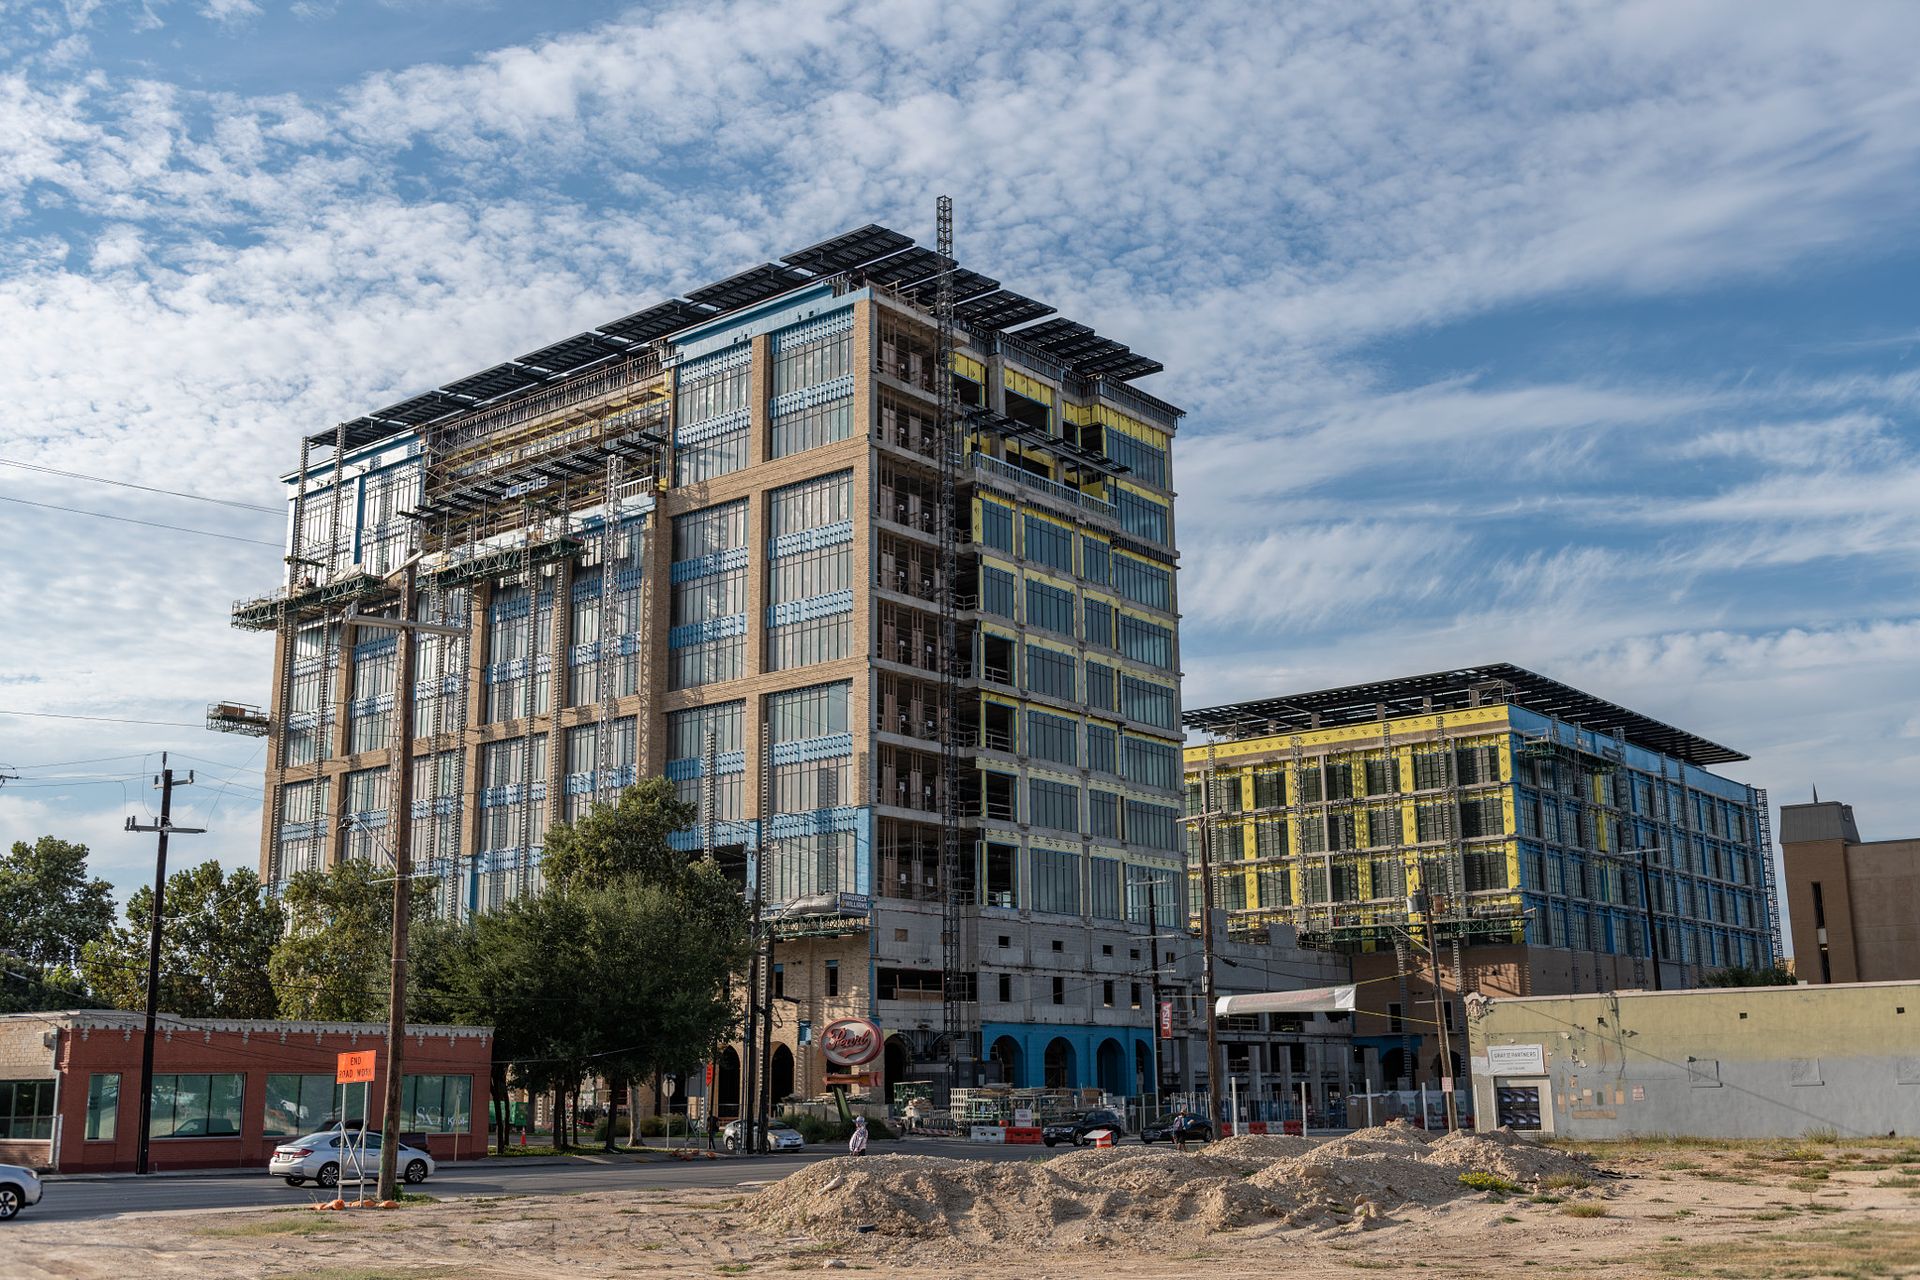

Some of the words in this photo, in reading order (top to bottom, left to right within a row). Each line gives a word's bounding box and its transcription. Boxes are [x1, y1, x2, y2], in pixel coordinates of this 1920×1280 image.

[501, 475, 548, 500] JOERIS
[826, 1028, 871, 1050] Pearl
[350, 1056, 361, 1065] END
[339, 1069, 353, 1078] ROAD
[357, 1068, 372, 1077] WORK
